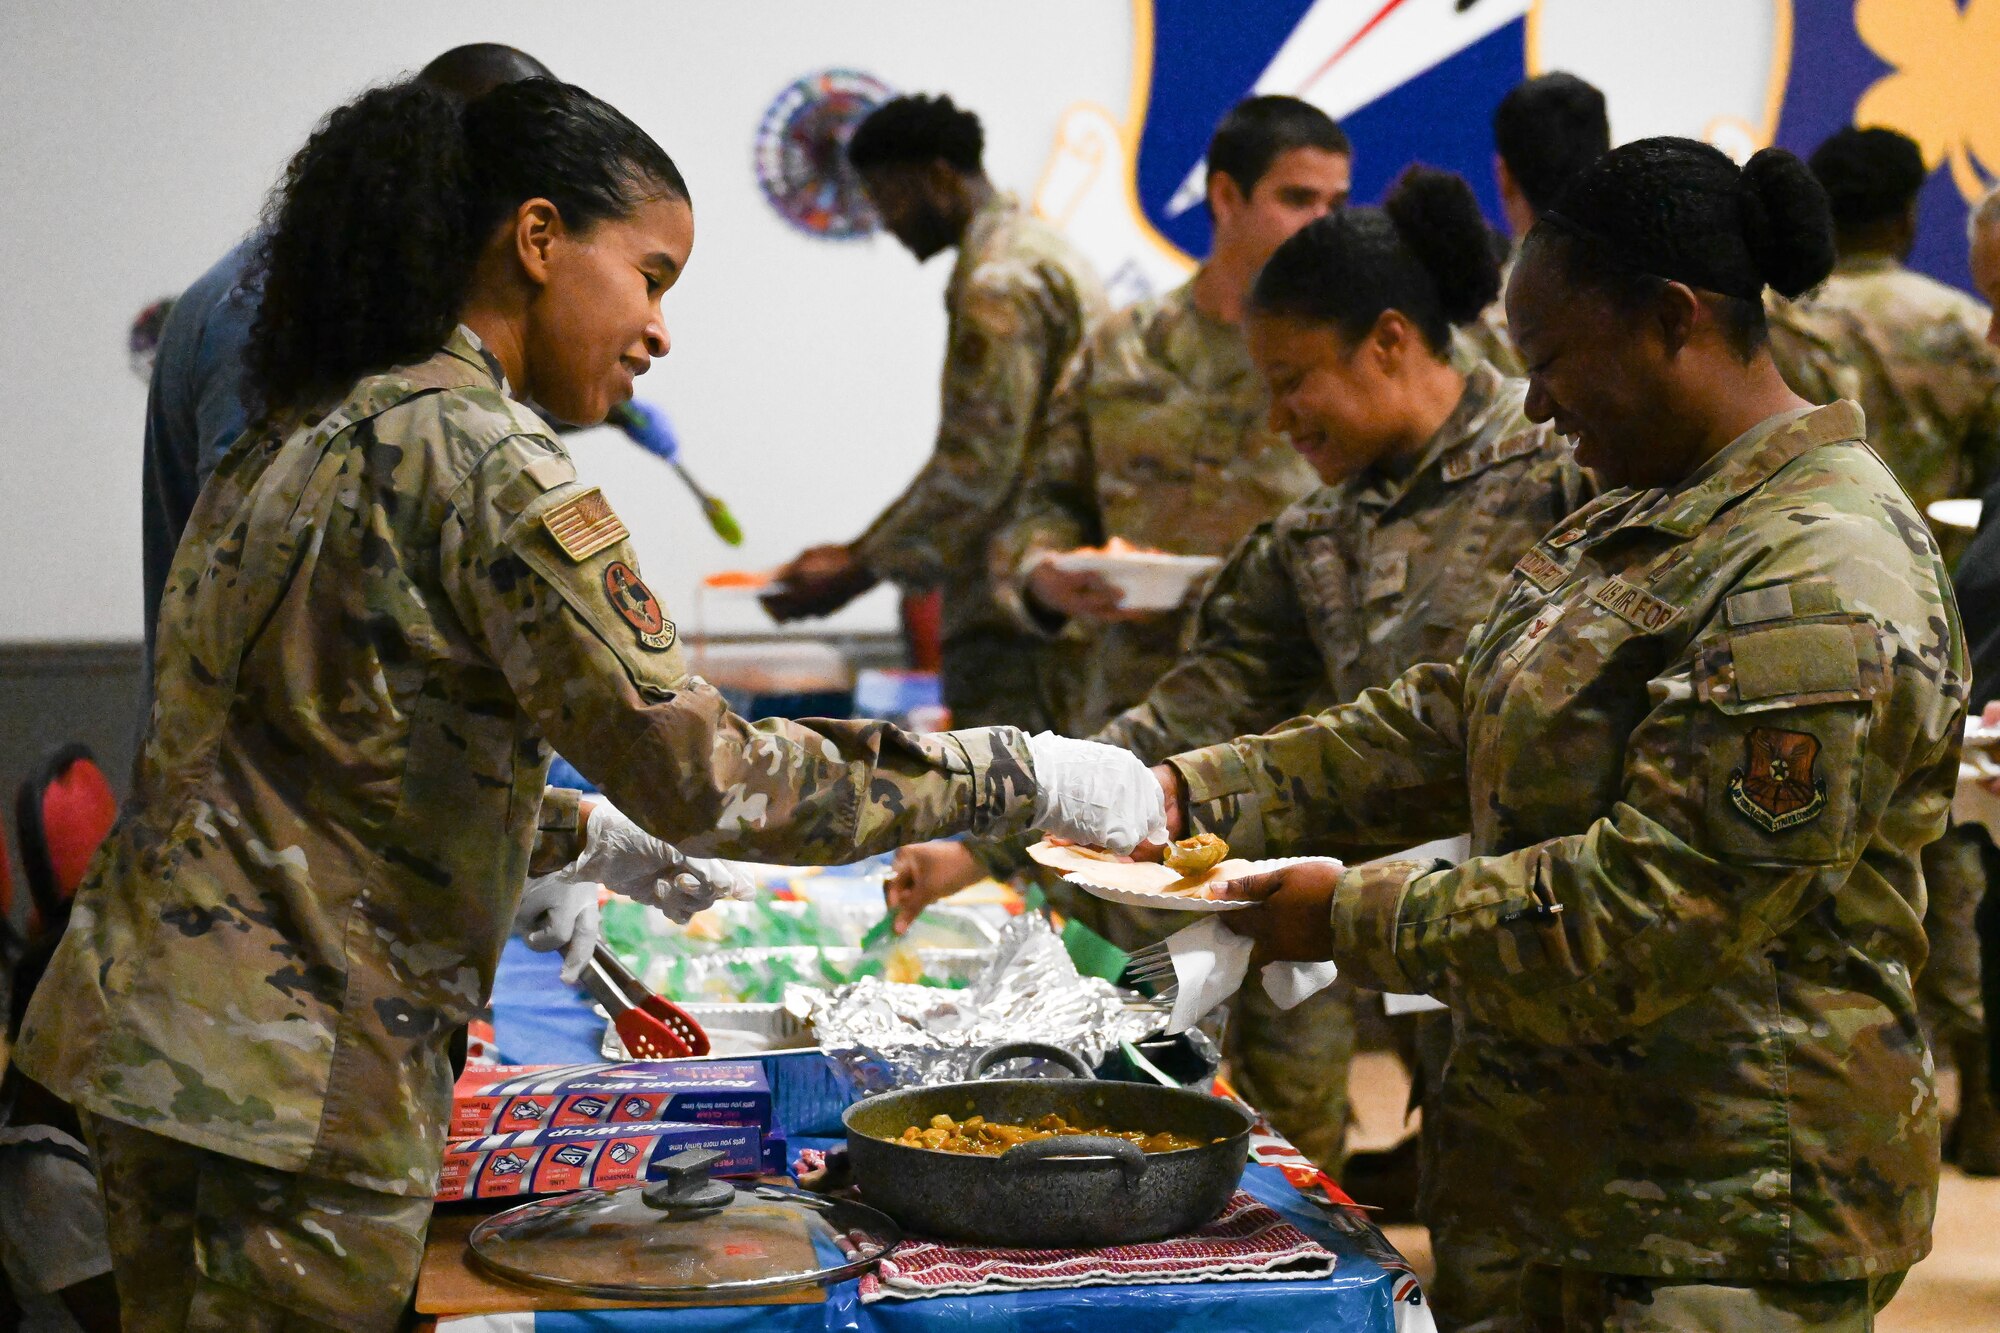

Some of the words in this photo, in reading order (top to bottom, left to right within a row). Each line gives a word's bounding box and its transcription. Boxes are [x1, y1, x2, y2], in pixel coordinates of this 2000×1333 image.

[1611, 588, 1638, 612] AIR
[567, 1082, 637, 1090] Wrap
[640, 1079, 758, 1088] Reynolds
[696, 1102, 713, 1110] family
[742, 1100, 756, 1108] gets
[549, 1127, 621, 1137] Wrap
[720, 1138, 732, 1146] you
[732, 1137, 746, 1146] gets
[683, 1142, 703, 1151] family
[596, 1174, 635, 1182] TRANSPORT
